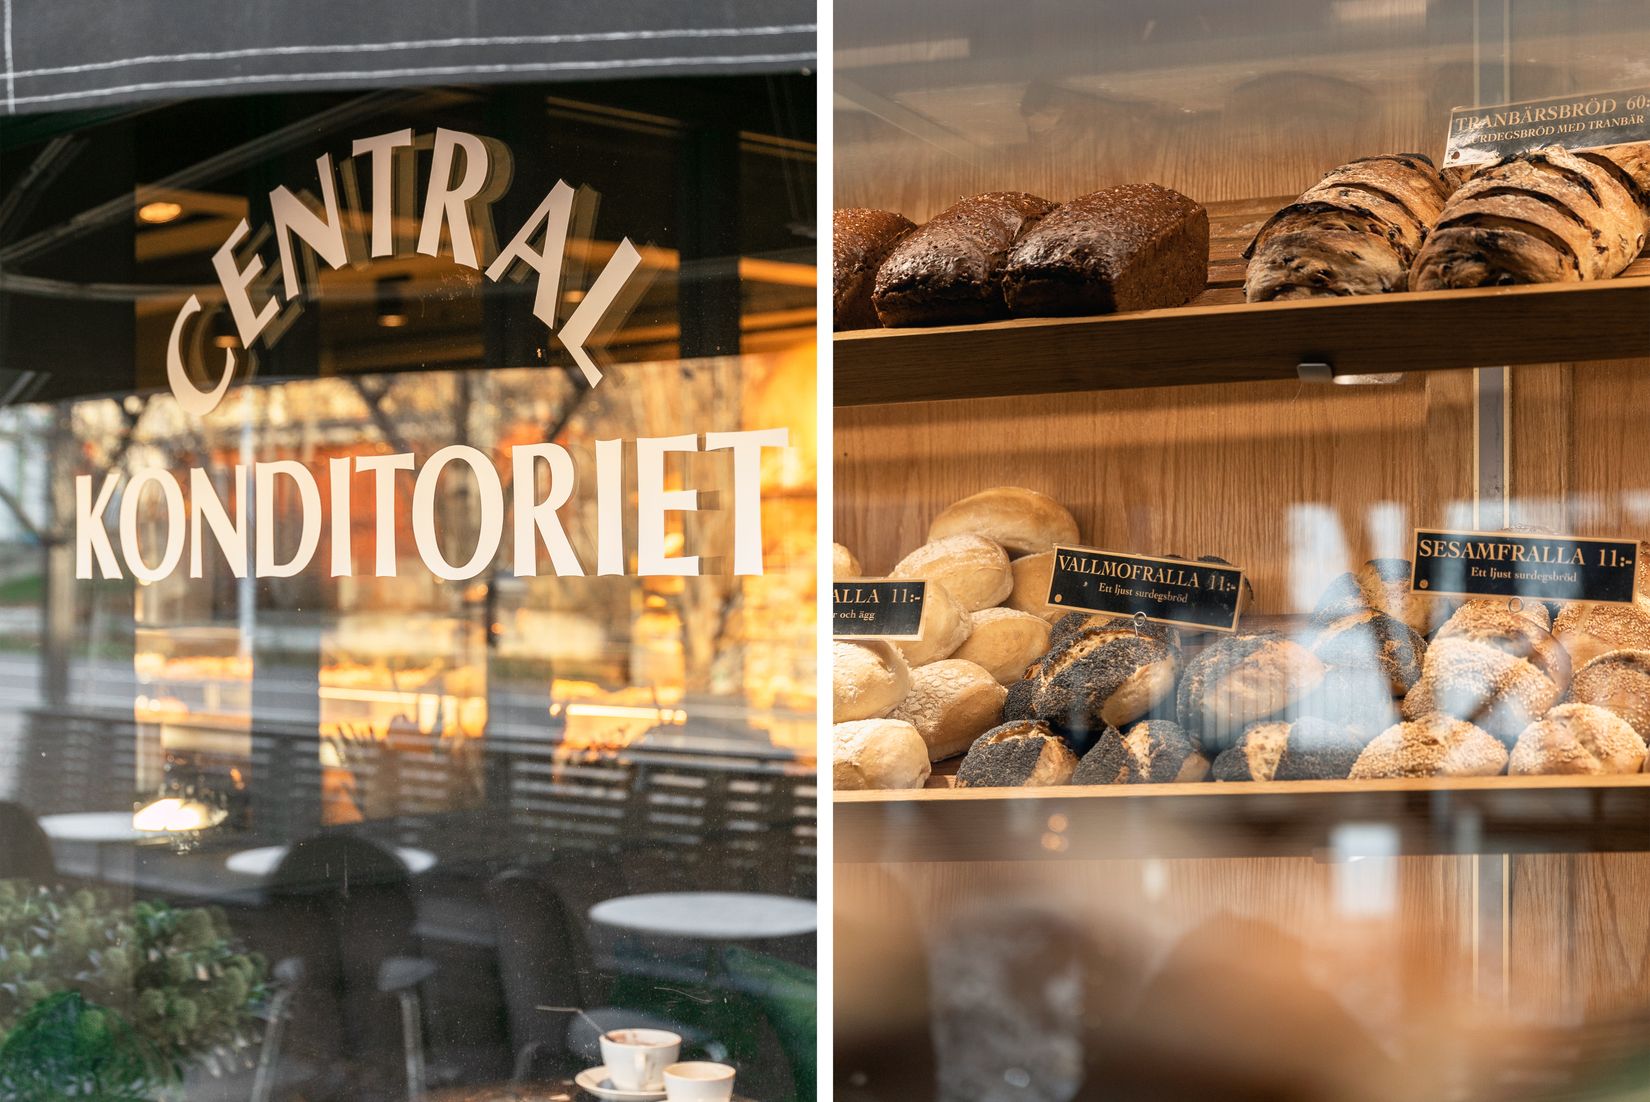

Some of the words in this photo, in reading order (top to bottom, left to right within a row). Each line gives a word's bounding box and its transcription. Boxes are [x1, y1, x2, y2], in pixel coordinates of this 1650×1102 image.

[1456, 97, 1617, 131] TRANBÄRSBRÖD
[1465, 126, 1555, 144] URDEGSBRÖD
[1557, 122, 1586, 134] MED
[1588, 113, 1644, 130] TRANBÄR
[166, 127, 642, 415] CENTRAL
[75, 427, 790, 581] KONDITORIET
[1419, 539, 1585, 566] SESAMFRALLA
[1599, 548, 1633, 568] 11:-
[1058, 554, 1200, 588] VALLMOFRALLA
[1471, 566, 1487, 578] Ett
[1489, 567, 1512, 580] ljust
[1514, 571, 1577, 584] surdegsbröd
[891, 588, 921, 603] 11:-
[1099, 582, 1113, 594] Ett
[1114, 584, 1133, 597] ljust
[1135, 588, 1188, 604] surdegsbröd
[840, 609, 856, 619] och
[858, 611, 876, 621] ägg
